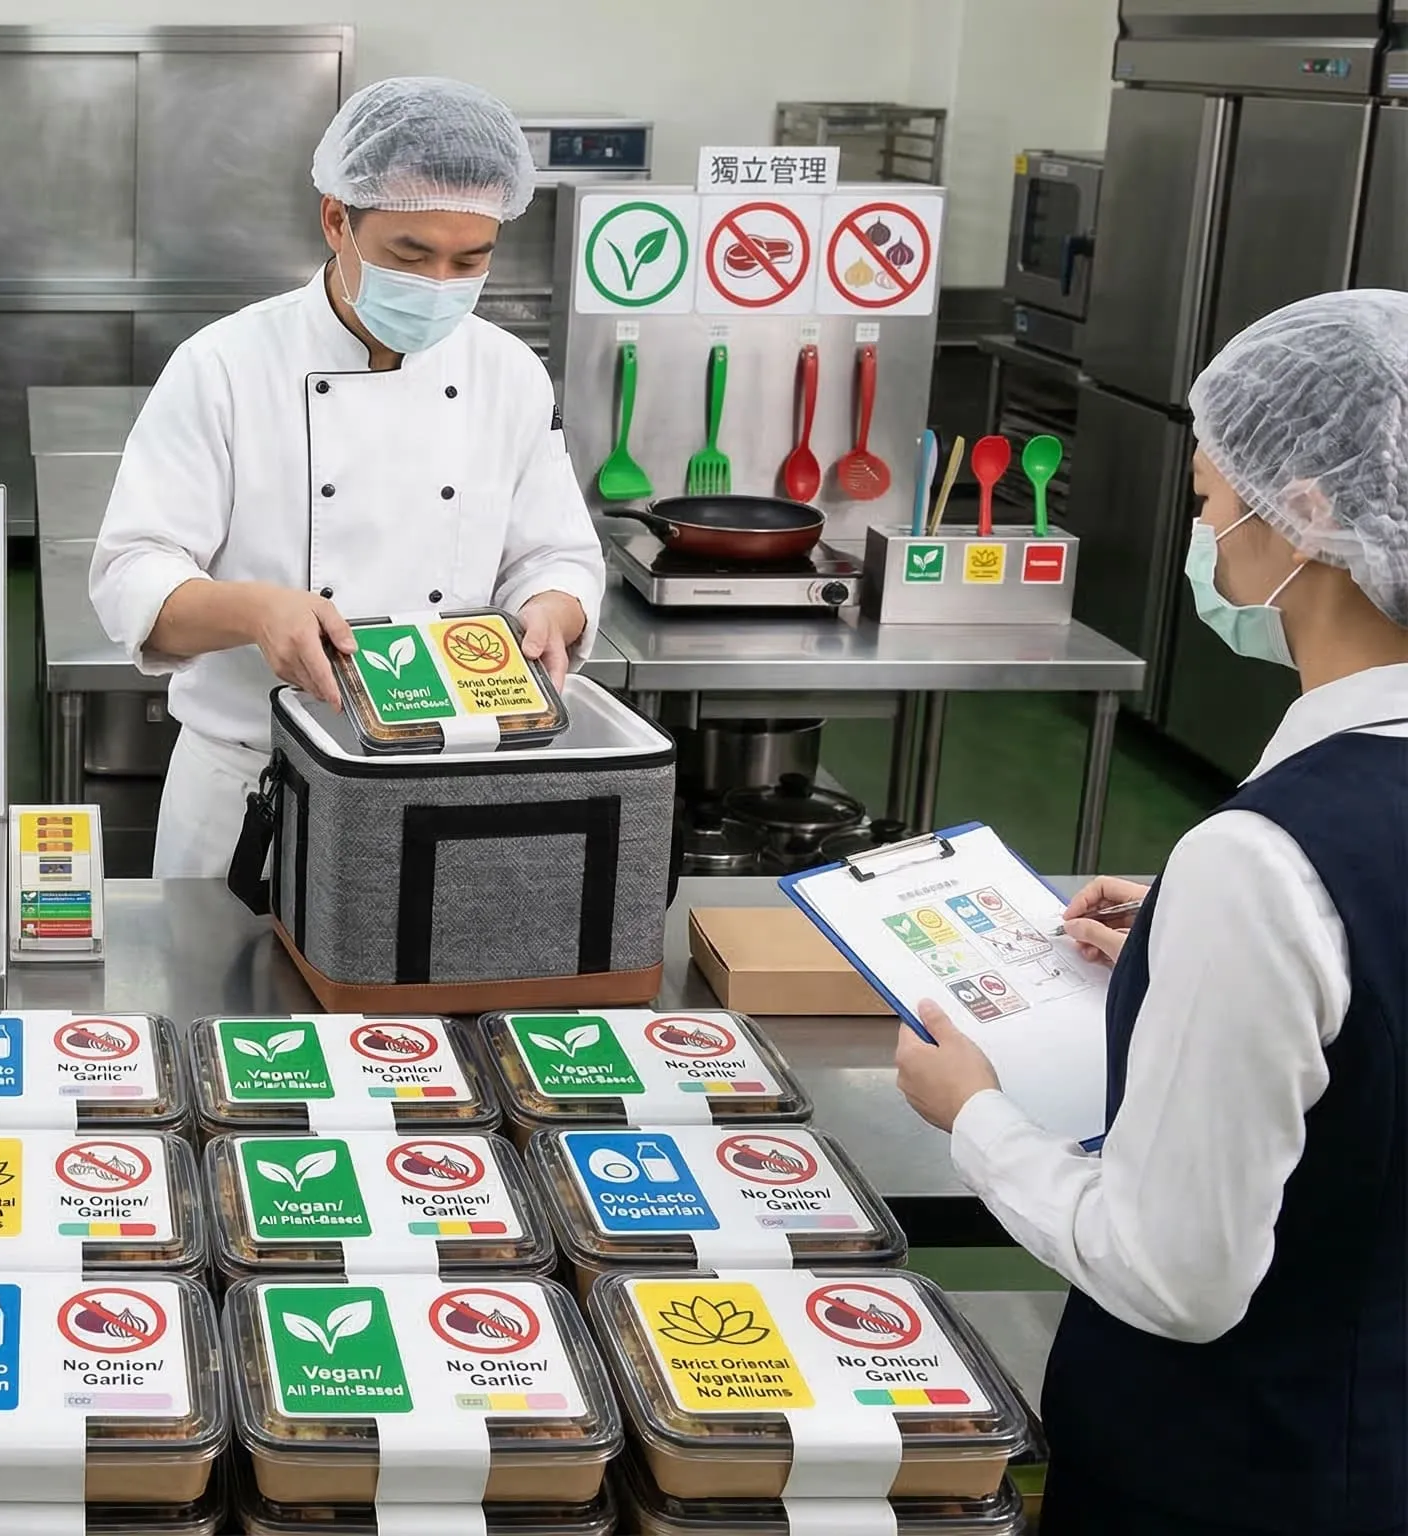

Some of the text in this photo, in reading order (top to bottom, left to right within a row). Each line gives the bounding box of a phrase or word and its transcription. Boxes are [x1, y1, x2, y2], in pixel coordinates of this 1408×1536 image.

[711, 156, 827, 185] 獨立管理
[58, 1063, 137, 1072] No Onion/
[362, 1064, 384, 1073] No
[550, 1064, 613, 1074] Vegan/
[664, 1060, 689, 1068] No
[74, 1072, 122, 1081] Garlic
[401, 1194, 490, 1206] No Onion/
[599, 1192, 697, 1204] Ovo-Lacto
[741, 1188, 831, 1200] No Onion/
[60, 1196, 149, 1206] No Onion/
[273, 1199, 343, 1214] Vegan/
[766, 1199, 822, 1211] Garlic
[78, 1207, 132, 1218] Garlic
[422, 1205, 478, 1216] Garlic
[259, 1215, 277, 1225] All
[63, 1359, 164, 1372] No Onion/
[447, 1359, 548, 1372] No Onion/
[837, 1355, 940, 1368] No Onion/
[83, 1372, 144, 1386] Garlic
[302, 1365, 383, 1382] Vegan/
[865, 1369, 929, 1383] Garlic
[470, 1373, 534, 1387] Garlic
[286, 1385, 307, 1396] All
[697, 1386, 726, 1398] No
